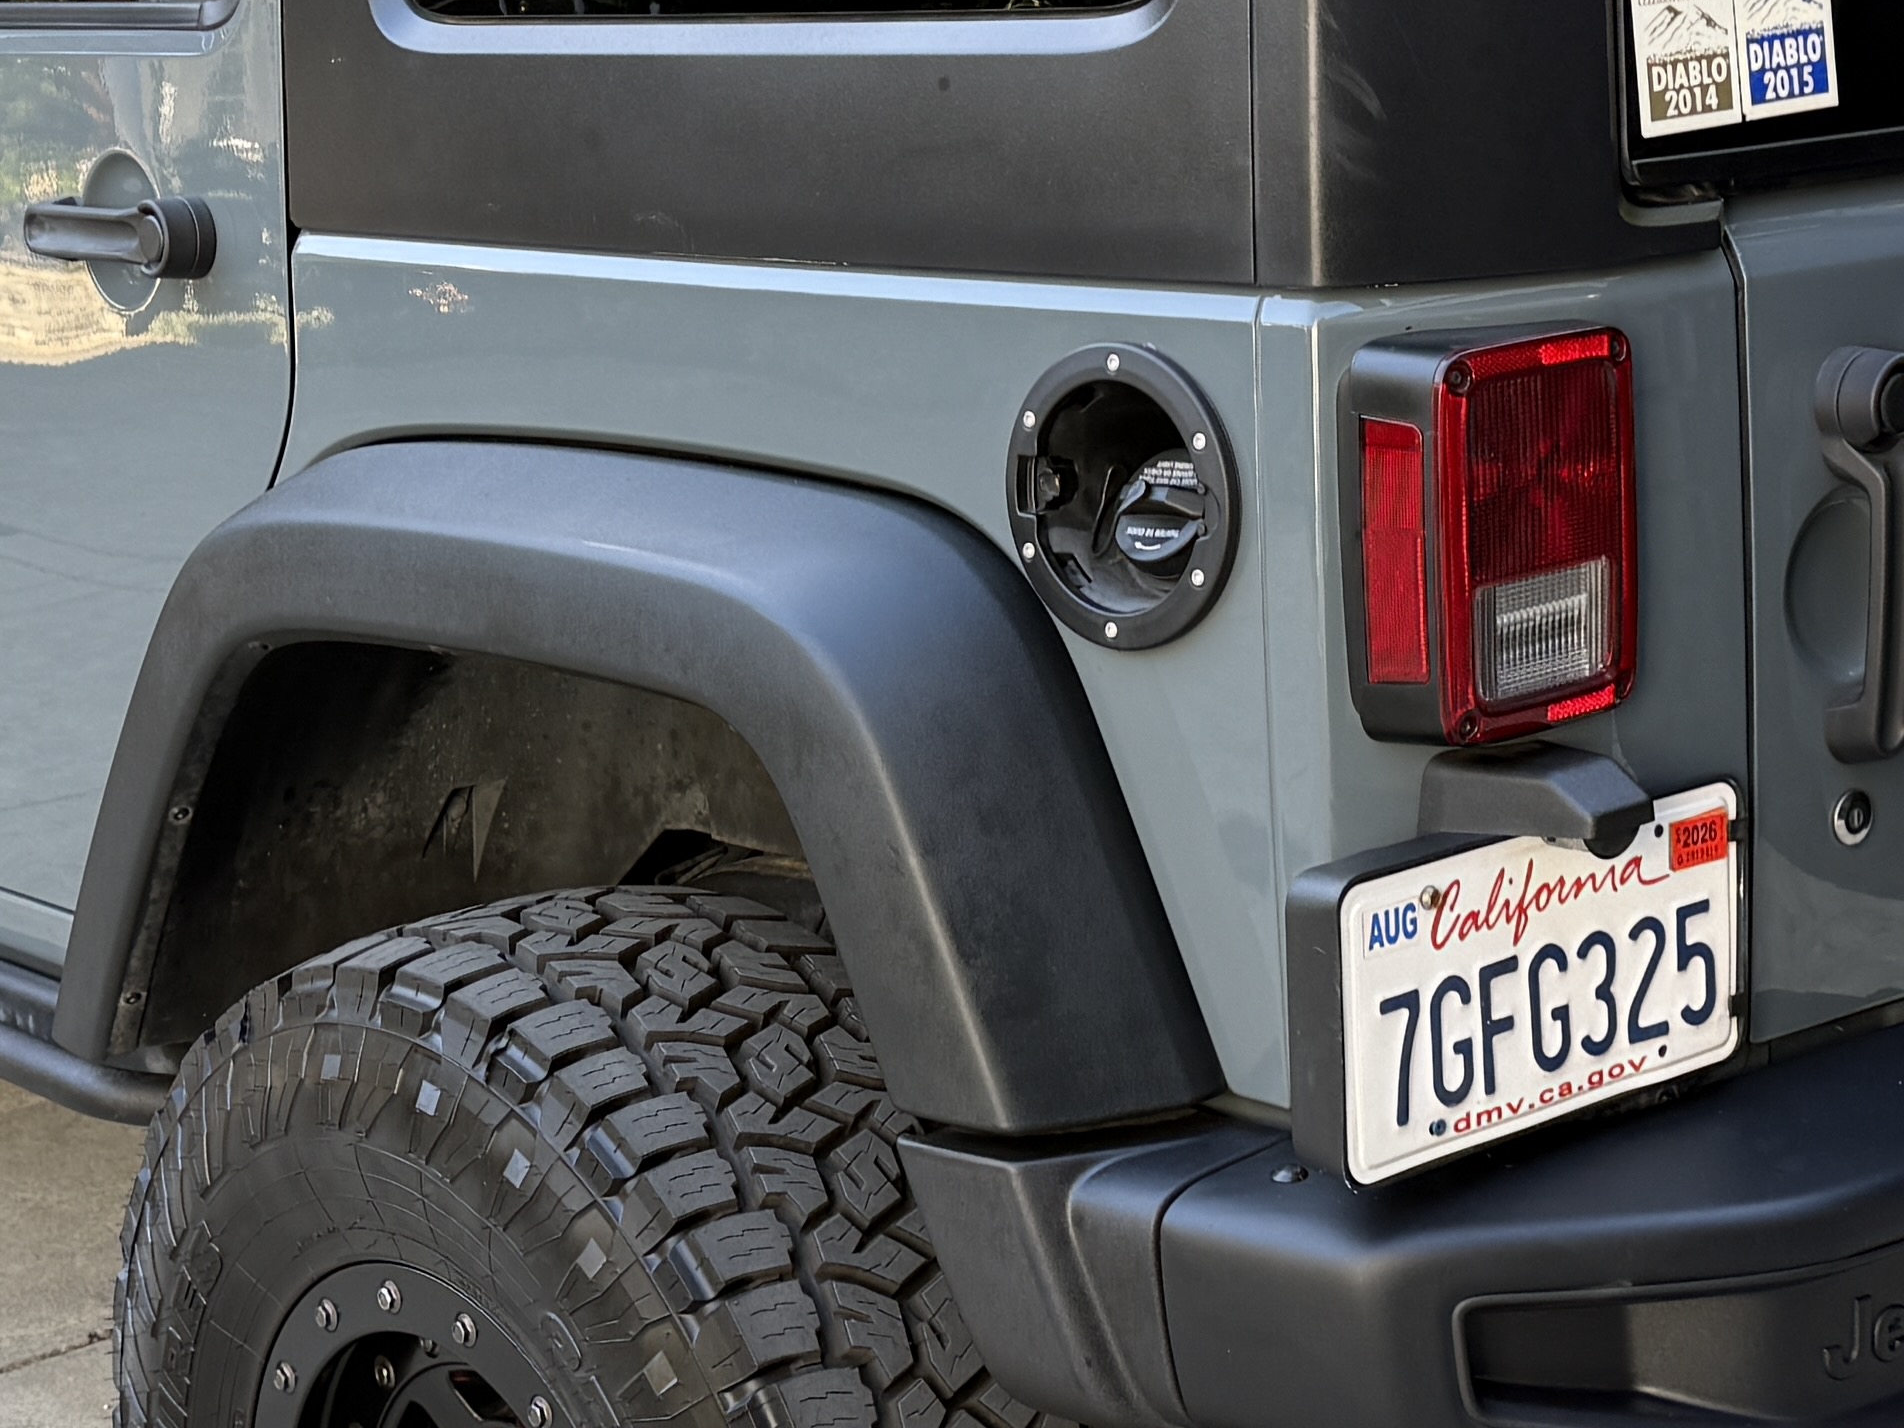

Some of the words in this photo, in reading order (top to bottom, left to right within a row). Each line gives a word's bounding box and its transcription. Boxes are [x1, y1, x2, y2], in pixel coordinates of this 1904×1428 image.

[1750, 32, 1821, 72] DIABLO
[1651, 57, 1728, 93] DIABLO
[1763, 65, 1815, 100] 2015
[1664, 84, 1719, 117] 2014
[1682, 819, 1718, 849] 2026
[1430, 855, 1670, 951] California
[1368, 901, 1419, 951] AUG
[1379, 898, 1717, 1127] 7GFG325
[1453, 1054, 1649, 1134] dmv.ca.gov
